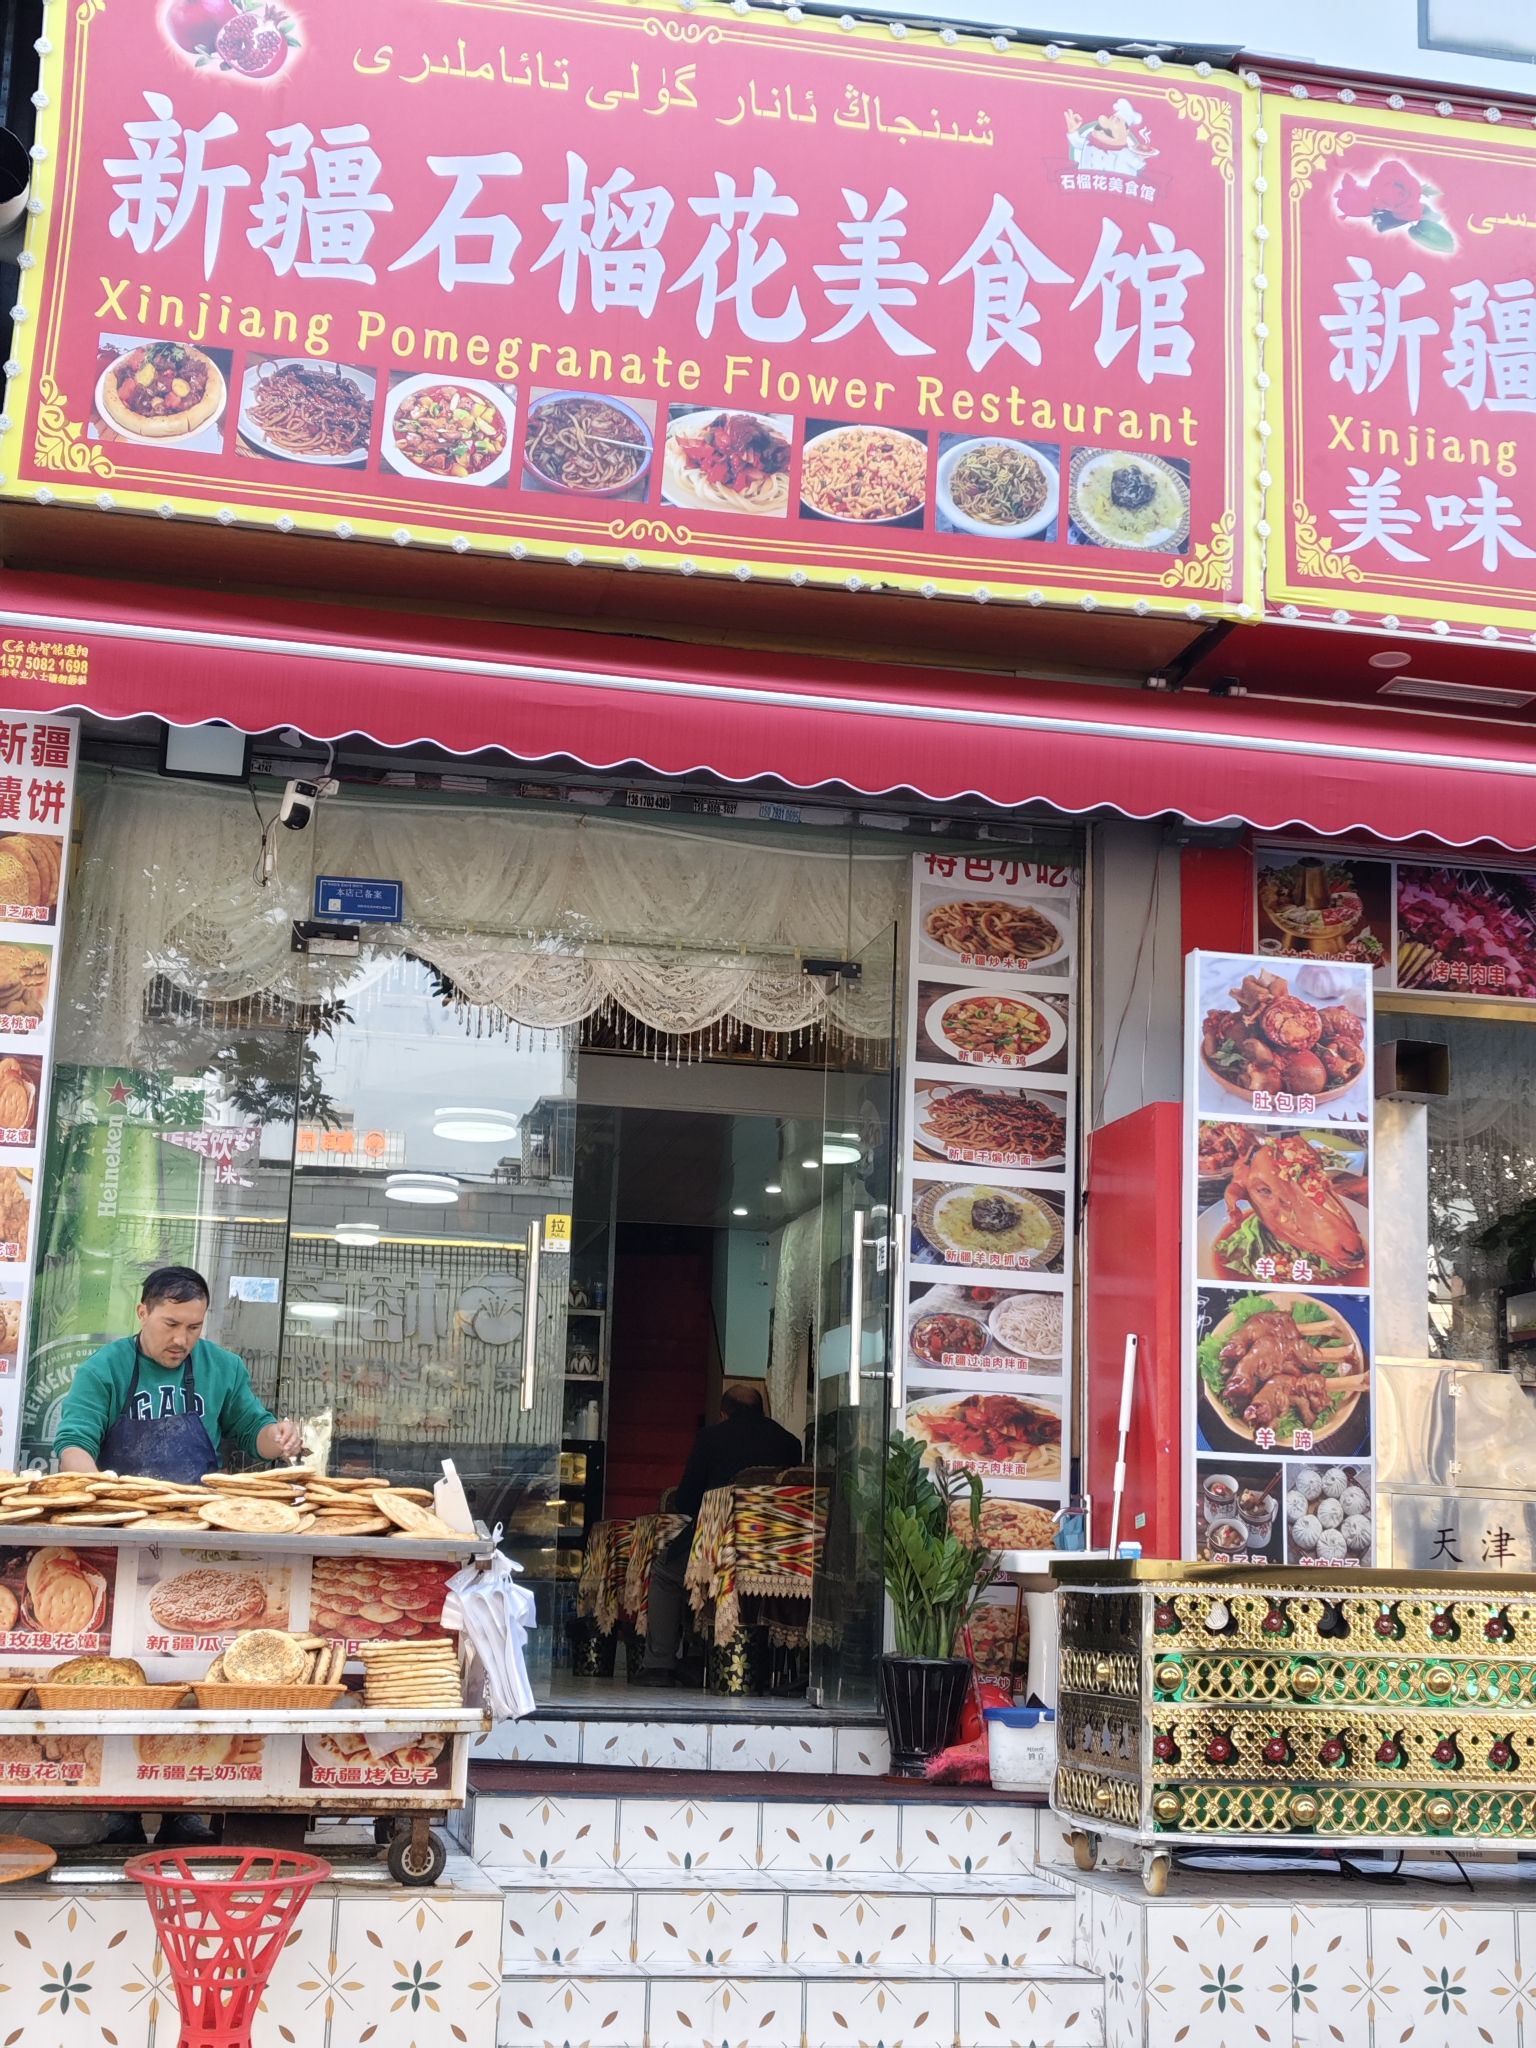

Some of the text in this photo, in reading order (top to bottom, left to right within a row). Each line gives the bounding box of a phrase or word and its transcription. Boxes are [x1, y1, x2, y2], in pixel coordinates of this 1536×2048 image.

[1060, 173, 1156, 202] 石榴花美食馆
[103, 91, 1204, 384] 新疆石榴花美食馆
[95, 276, 1200, 447] Xinjiang Pomegranate Flower Restaurant
[1328, 415, 1518, 477] Xinjiang
[1330, 466, 1536, 572] 美味
[25, 656, 55, 672] 5082
[58, 658, 89, 674] 1698
[960, 953, 1029, 970] 新疆炒米粉
[1431, 959, 1506, 987] 烤羊肉串
[958, 1051, 1027, 1067] 新疆大盘鸡
[1253, 1091, 1317, 1114] 肚包肉
[97, 1114, 124, 1218] Heineken
[551, 1219, 565, 1233] 拉
[945, 1249, 1031, 1268] 新疆羊肉抓饭
[1255, 1258, 1314, 1282] 羊头
[941, 1353, 1029, 1372] 新疆过油肉拌面
[1255, 1427, 1314, 1451] 羊蹄
[1428, 1526, 1518, 1568] 天津
[136, 1764, 264, 1782] 新疆牛奶馕
[311, 1767, 438, 1785] 新疆烤包子
